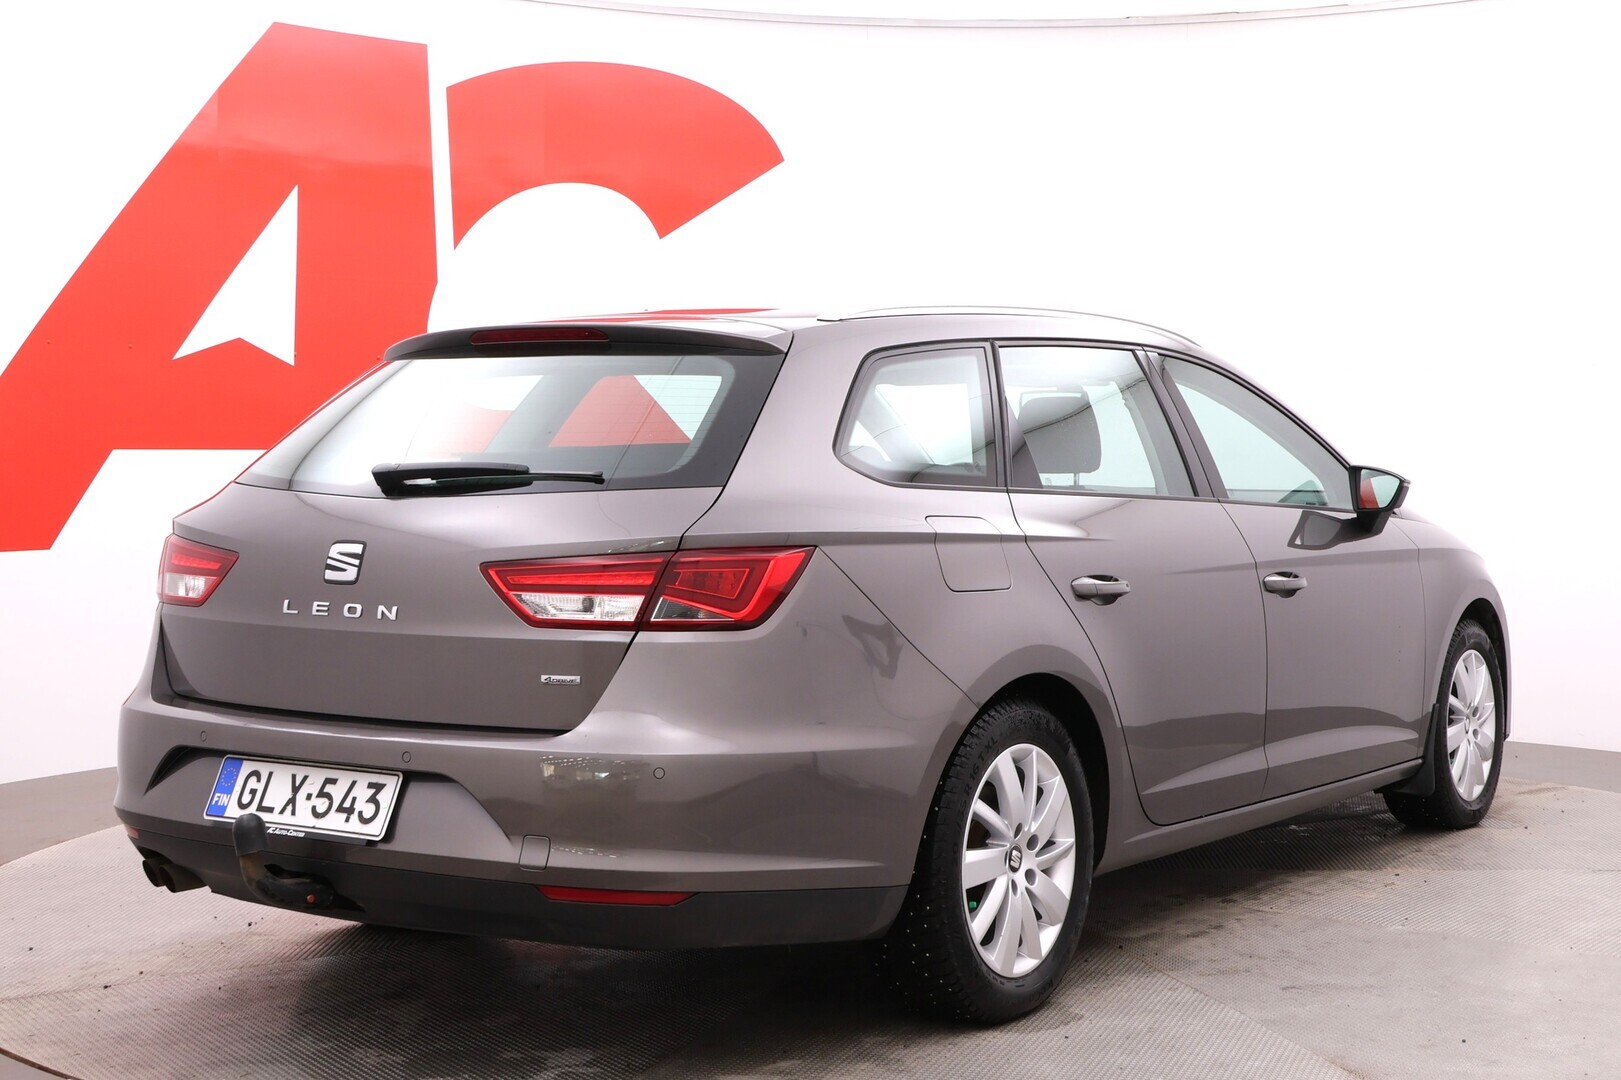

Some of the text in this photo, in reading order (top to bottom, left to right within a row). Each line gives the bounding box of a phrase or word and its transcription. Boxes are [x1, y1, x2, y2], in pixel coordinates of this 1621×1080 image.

[282, 599, 399, 621] LEON
[211, 792, 231, 807] FIN
[237, 769, 388, 825] GLX-543
